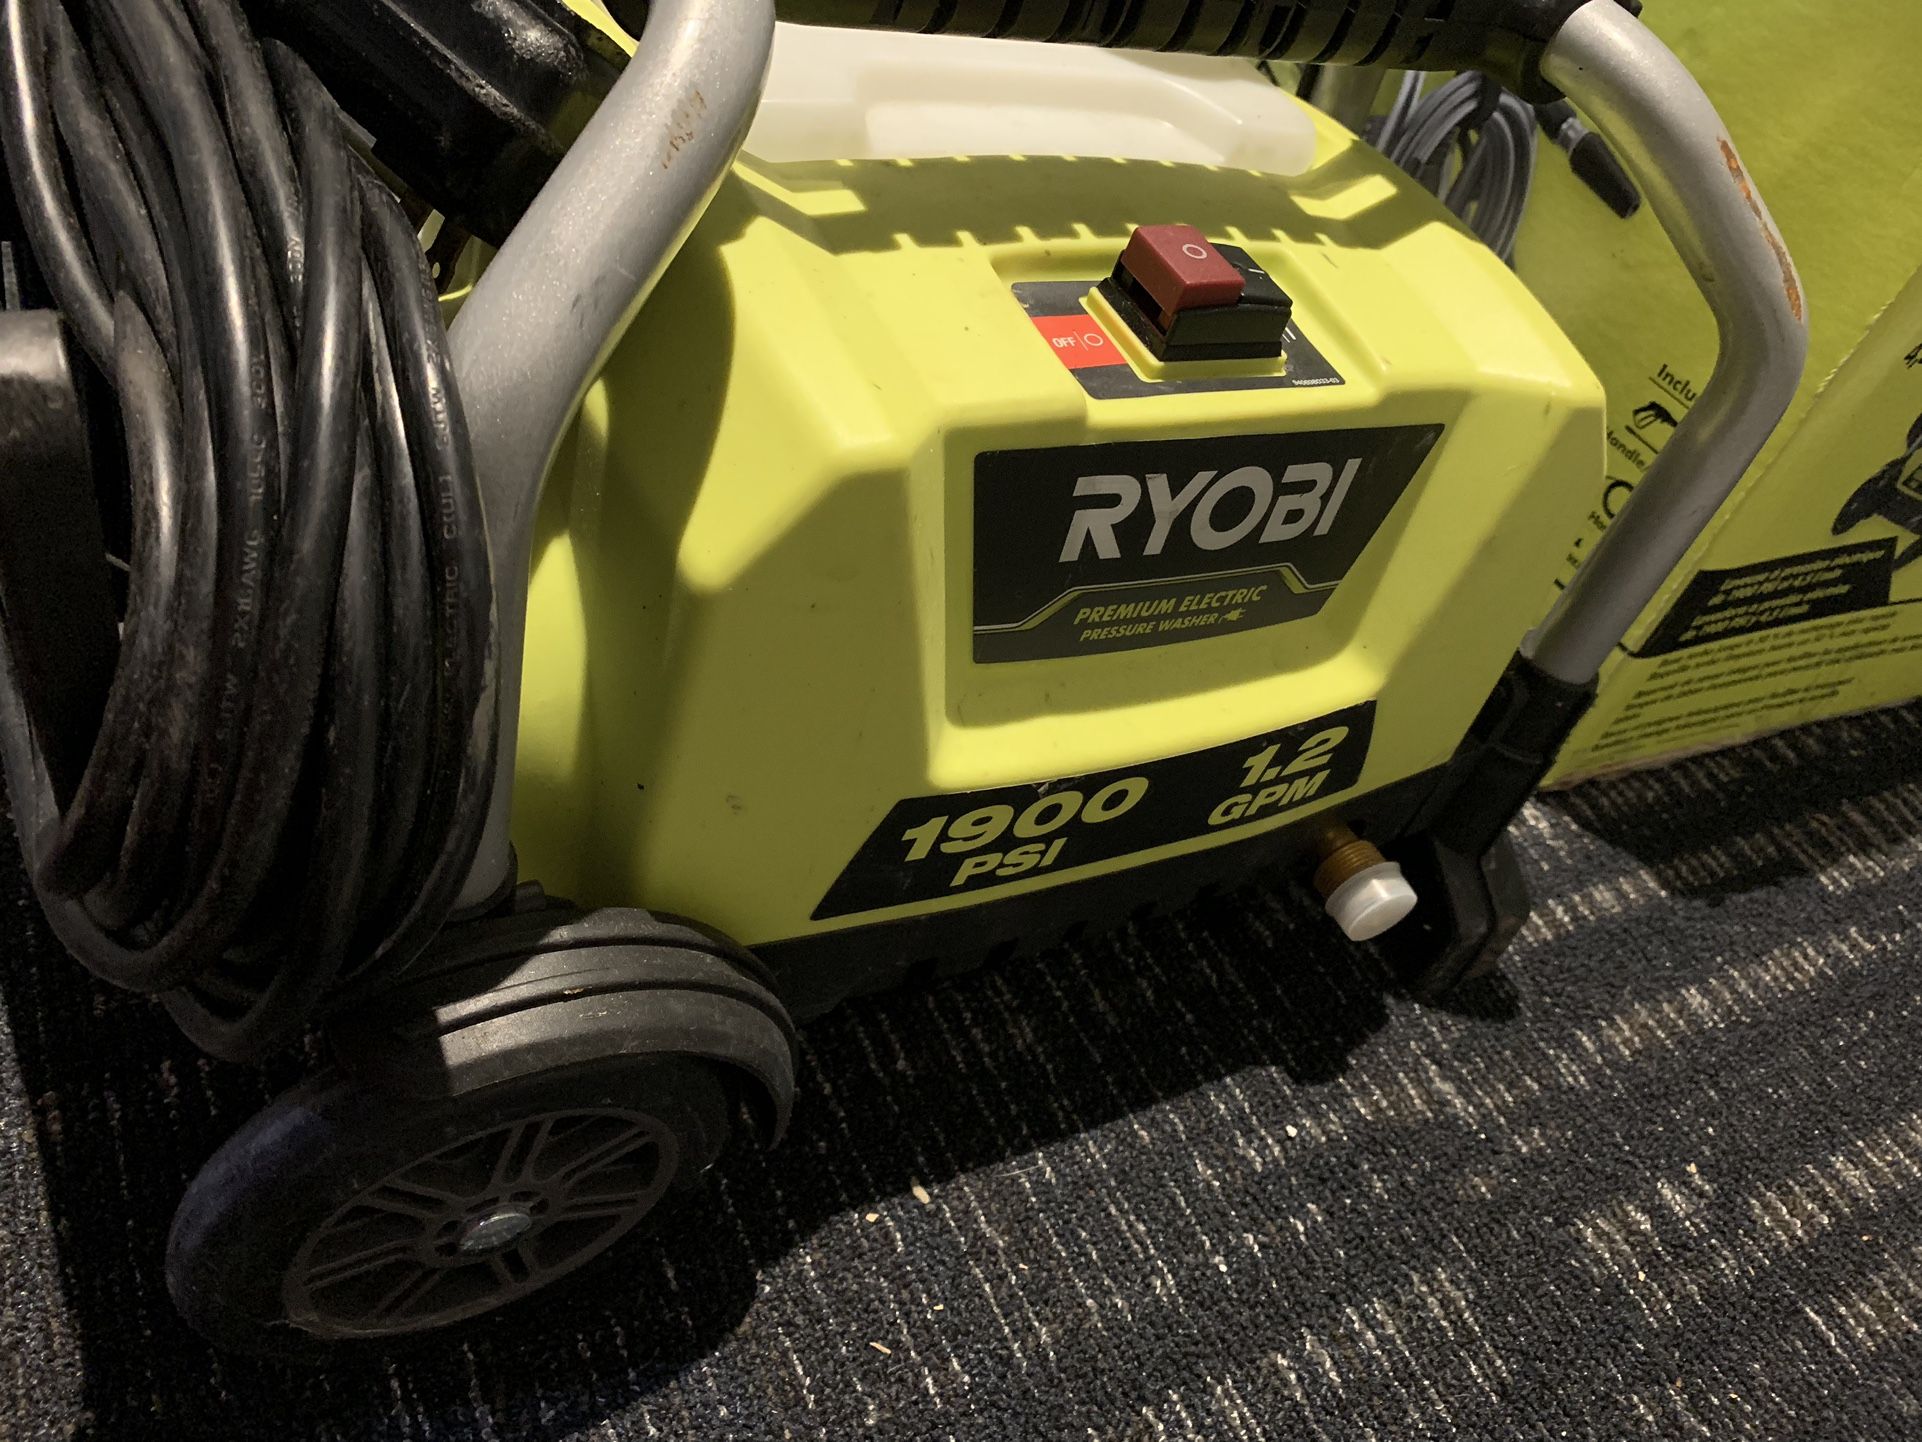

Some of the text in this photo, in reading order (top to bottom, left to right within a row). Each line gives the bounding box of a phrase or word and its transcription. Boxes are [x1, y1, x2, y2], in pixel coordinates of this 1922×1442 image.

[1052, 336, 1077, 348] OFF
[1059, 458, 1362, 563] RYOBI
[1073, 585, 1268, 625] PREMIUM ELECTRIC
[1079, 612, 1219, 642] PRESSURE WASHER
[1240, 726, 1349, 788] 1.2
[900, 776, 1149, 862] 1900
[1207, 769, 1325, 826] GPM
[949, 837, 1068, 887] PSI
